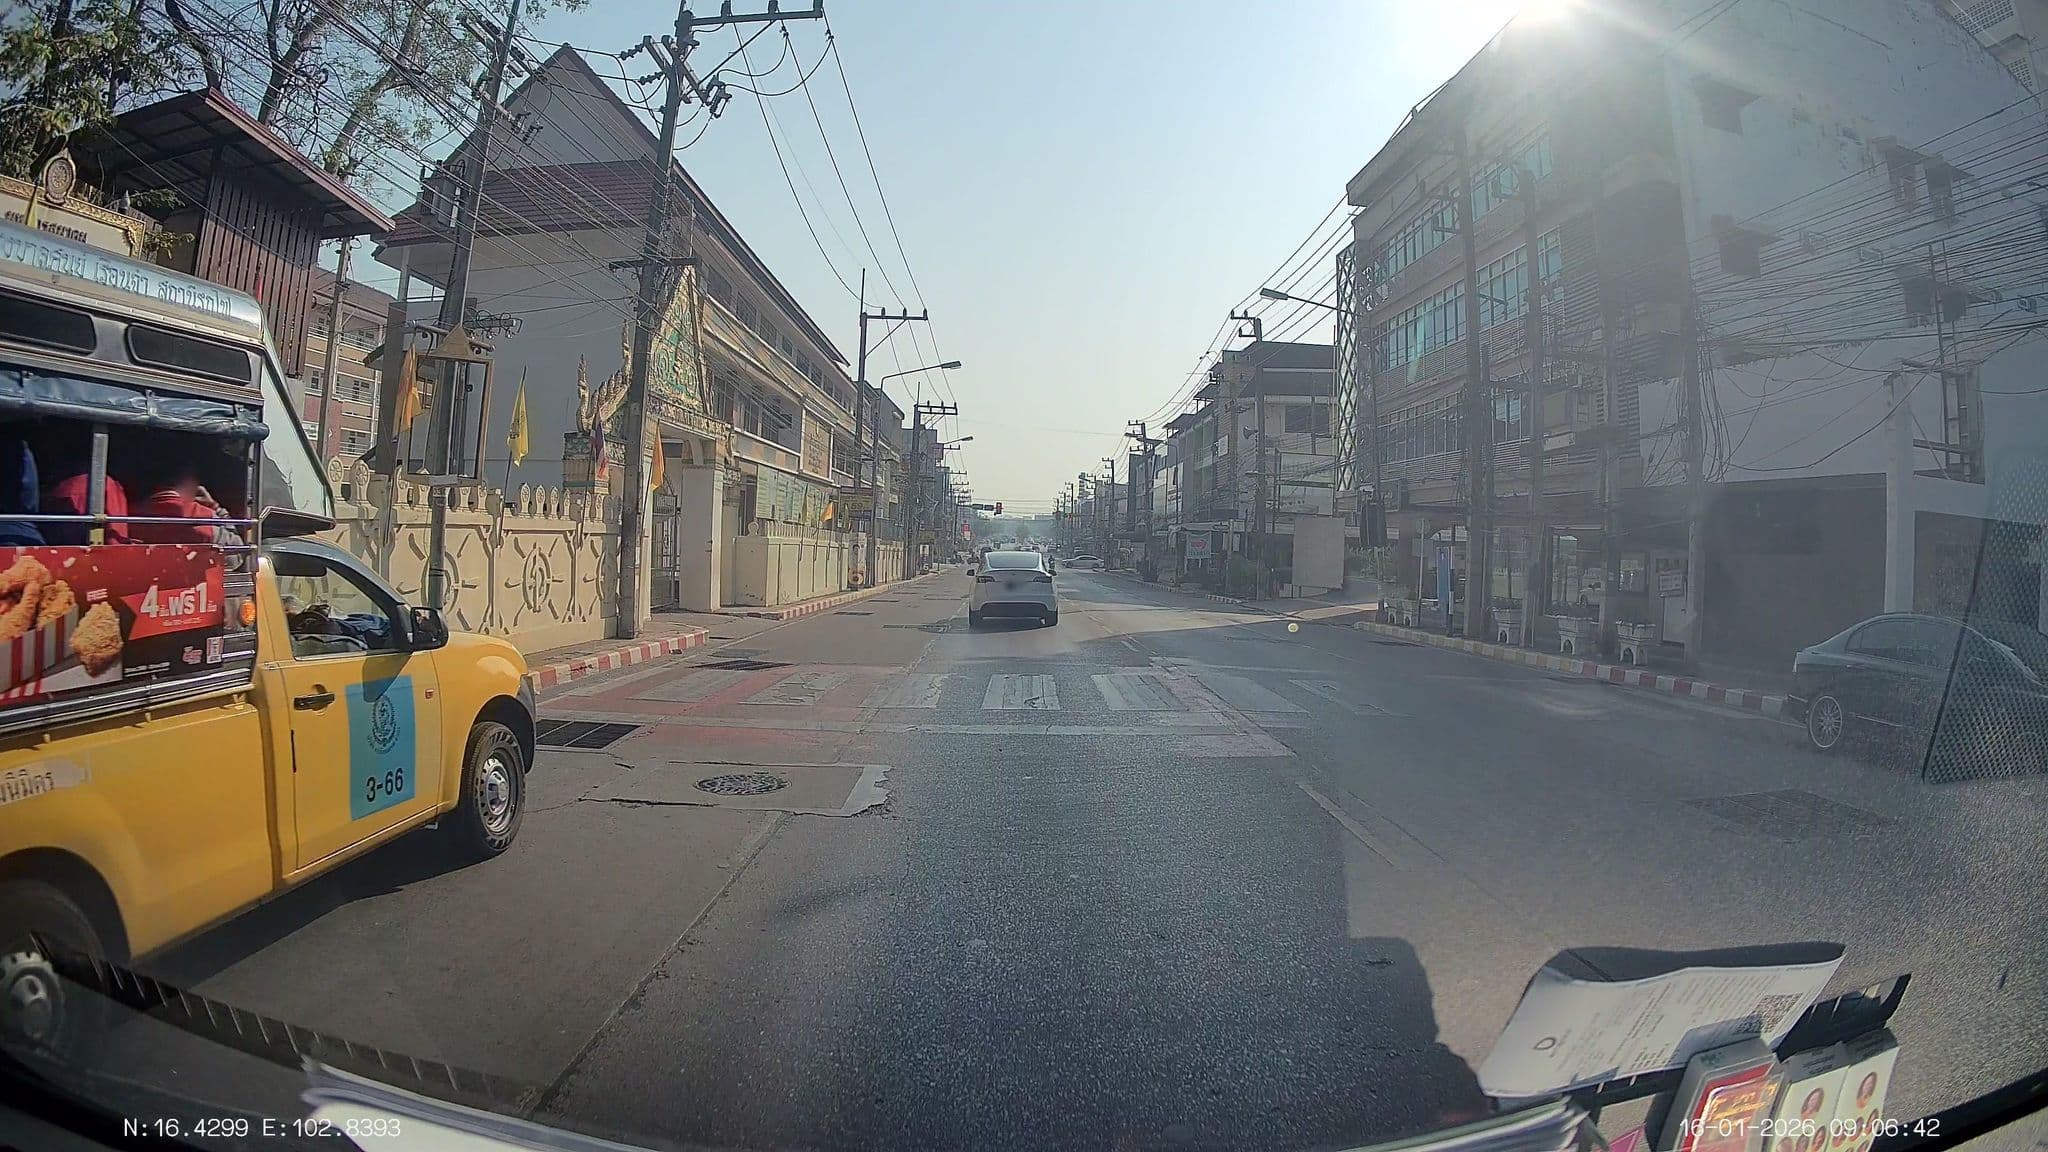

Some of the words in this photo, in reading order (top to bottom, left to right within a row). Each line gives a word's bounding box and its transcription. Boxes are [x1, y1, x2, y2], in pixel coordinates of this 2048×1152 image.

[157, 280, 232, 319] สถานีรถไฟ
[140, 584, 159, 618] 4
[196, 582, 208, 613] 1
[366, 767, 404, 802] 3-66
